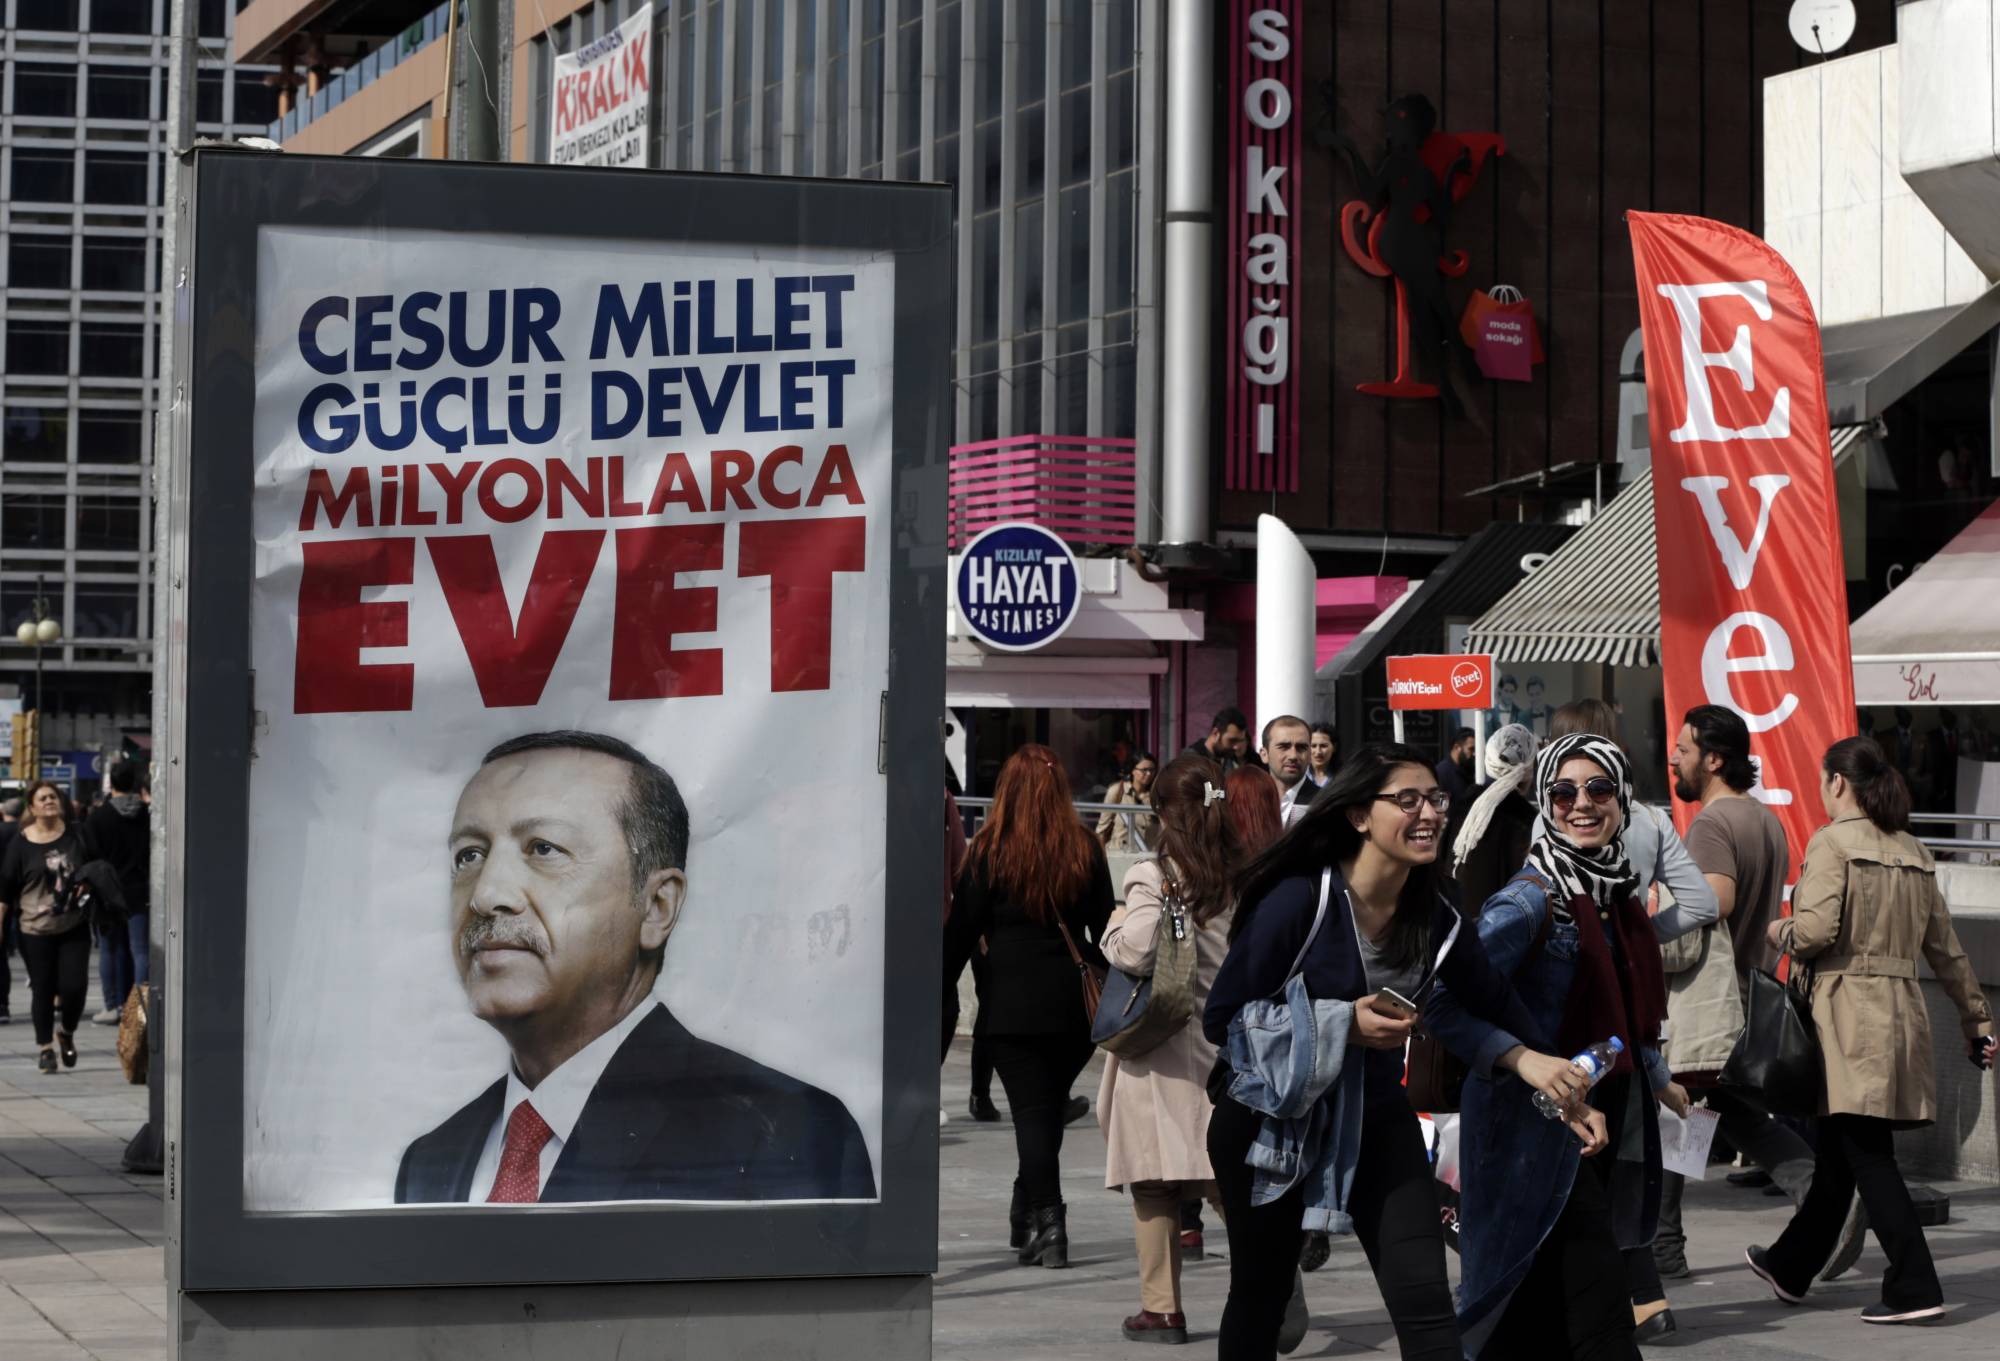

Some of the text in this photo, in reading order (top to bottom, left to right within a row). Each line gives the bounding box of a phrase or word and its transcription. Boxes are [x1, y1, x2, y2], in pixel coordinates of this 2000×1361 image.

[1243, 9, 1292, 454] sokağı
[298, 287, 565, 375] CESUR
[1486, 332, 1523, 346] sokağı
[1489, 321, 1521, 331] moda
[298, 359, 855, 454] GÜÇLÜ DEVLET
[995, 548, 1043, 562] KIZILAY
[968, 556, 1068, 604] HAYAT
[294, 516, 867, 715] EVET
[1453, 670, 1480, 689] Evet
